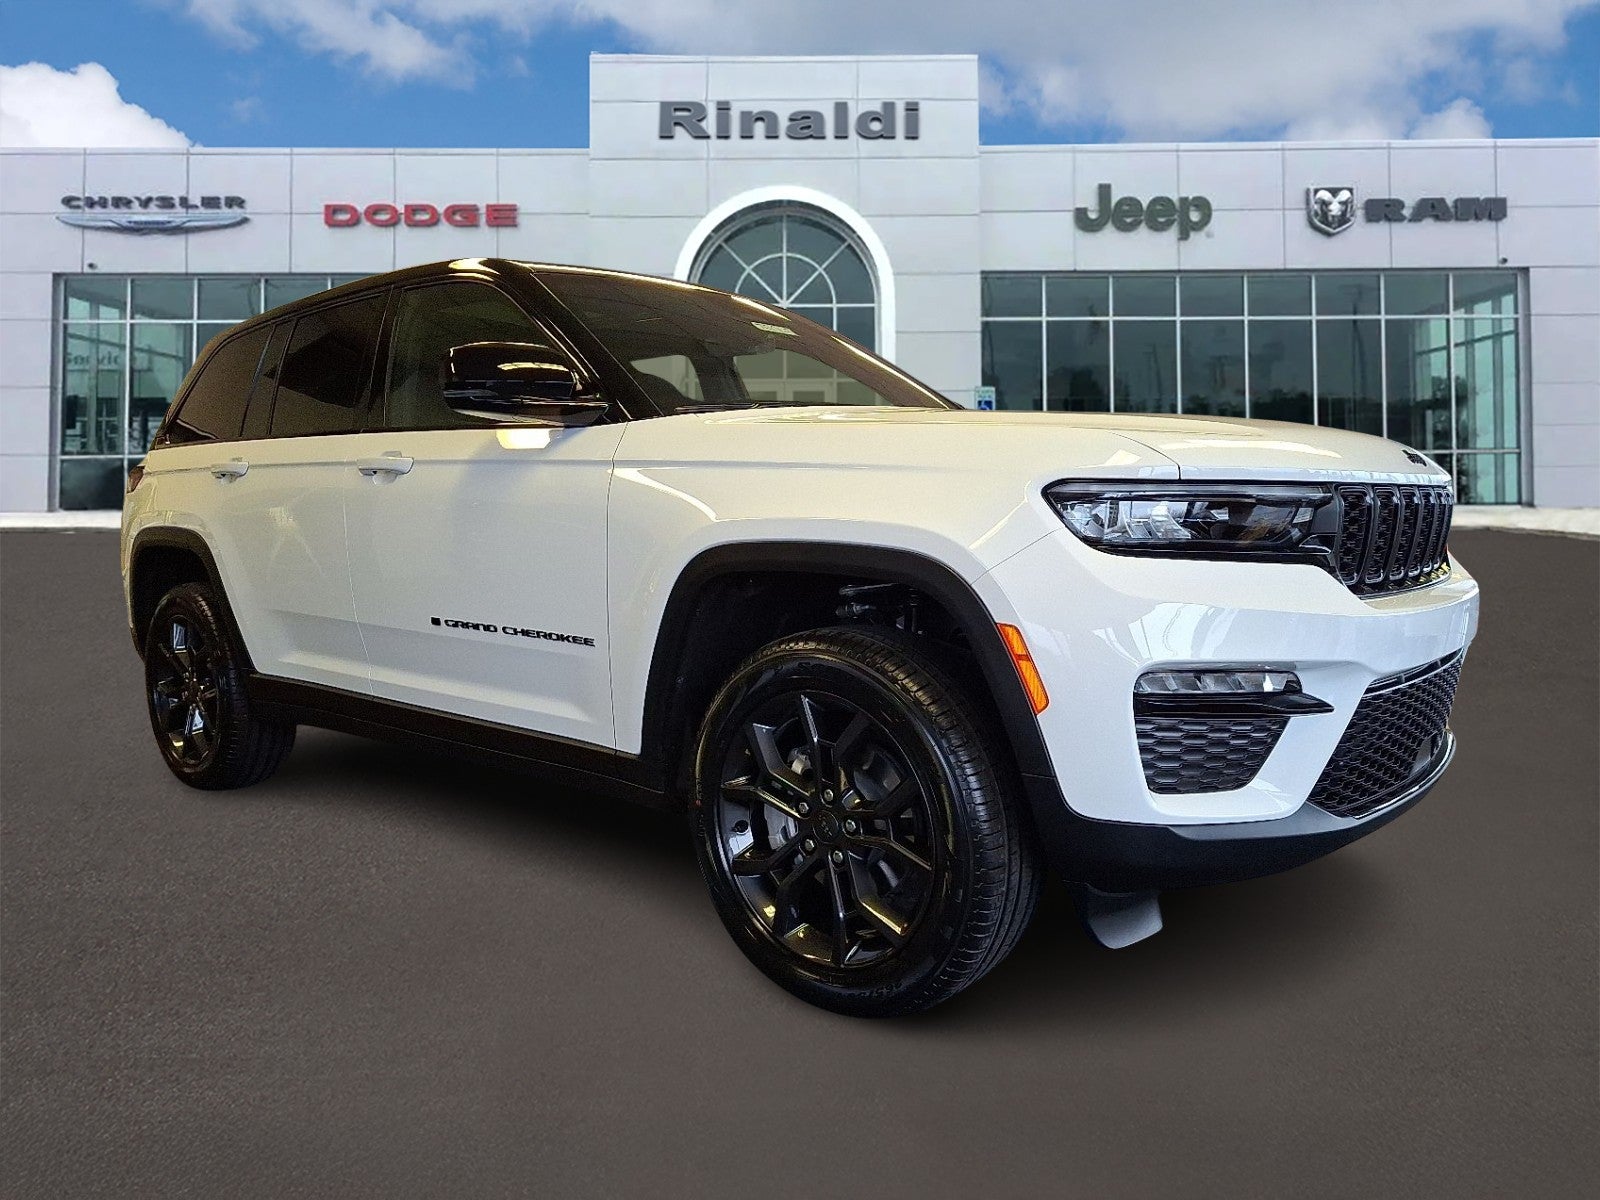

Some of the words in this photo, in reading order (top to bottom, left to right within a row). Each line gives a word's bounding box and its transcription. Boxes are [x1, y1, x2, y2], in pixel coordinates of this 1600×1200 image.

[659, 101, 919, 139] Rinaldi
[61, 195, 246, 209] CHRYSLER
[324, 204, 518, 227] DODGE
[1074, 183, 1212, 241] Jeep
[1365, 197, 1507, 223] RAM
[444, 619, 498, 633] GRAND
[502, 626, 595, 647] CHEROKEE
